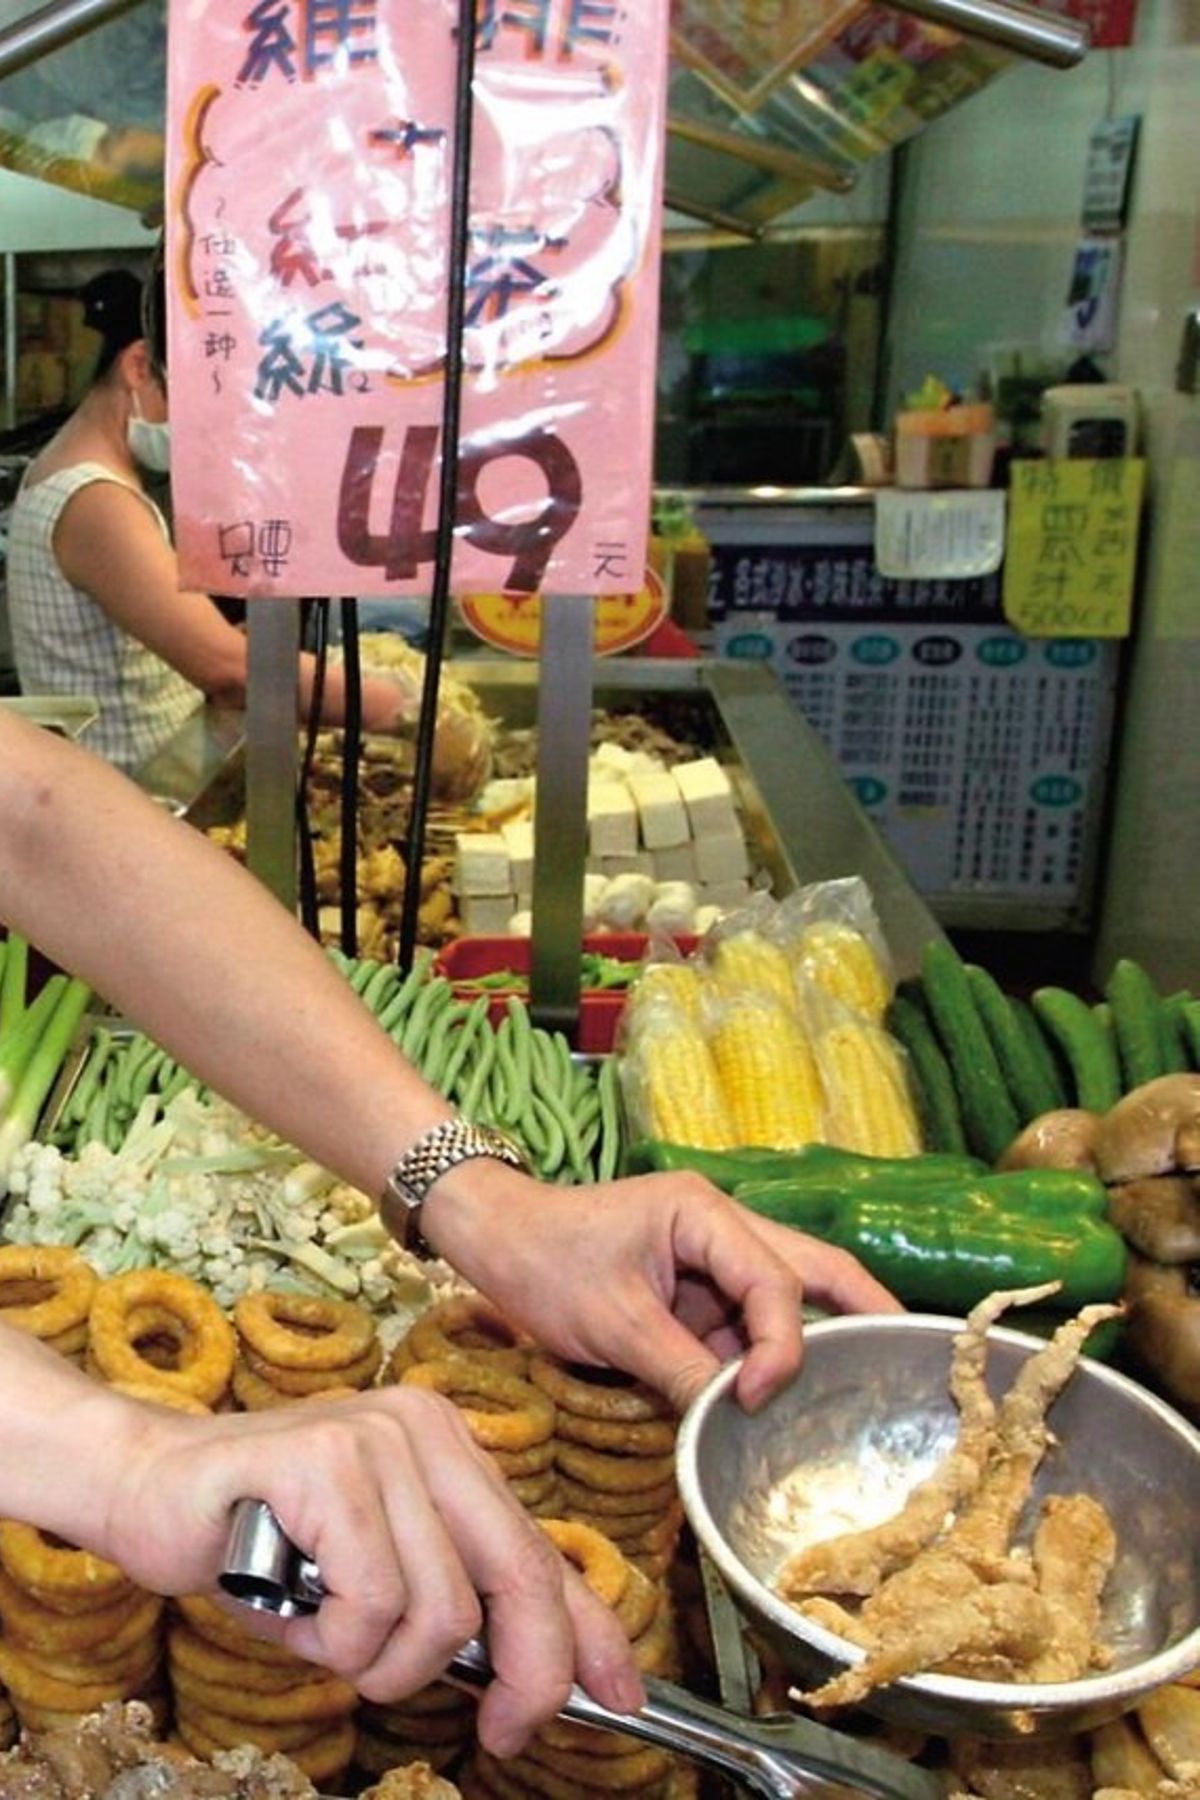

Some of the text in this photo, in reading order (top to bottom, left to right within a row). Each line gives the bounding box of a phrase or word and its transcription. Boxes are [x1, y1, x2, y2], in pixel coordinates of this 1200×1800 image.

[218, 424, 627, 593] 只要 49 元
